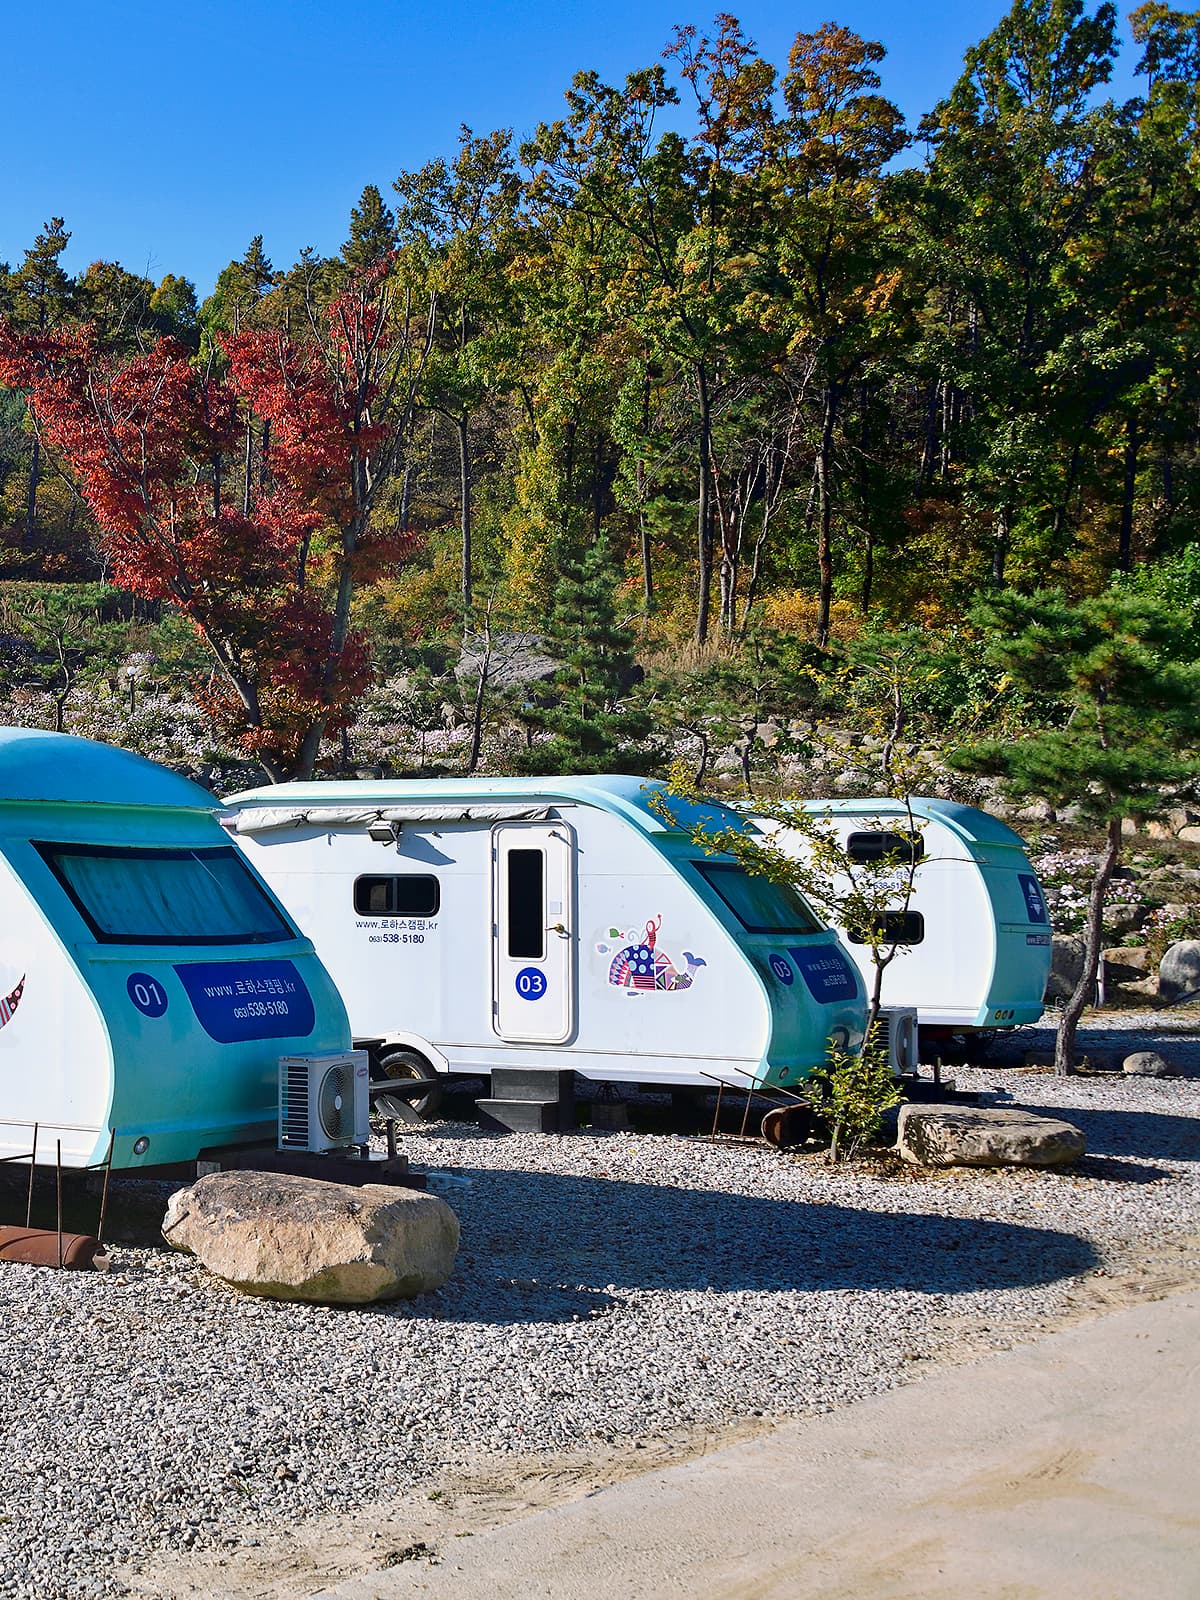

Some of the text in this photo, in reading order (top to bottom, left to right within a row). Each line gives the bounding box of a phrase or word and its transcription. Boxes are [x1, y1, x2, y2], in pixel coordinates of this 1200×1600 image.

[773, 960, 791, 978] 03
[203, 979, 297, 998] www.로하스캠핑.kr
[519, 975, 543, 993] 03
[134, 982, 163, 1007] 01
